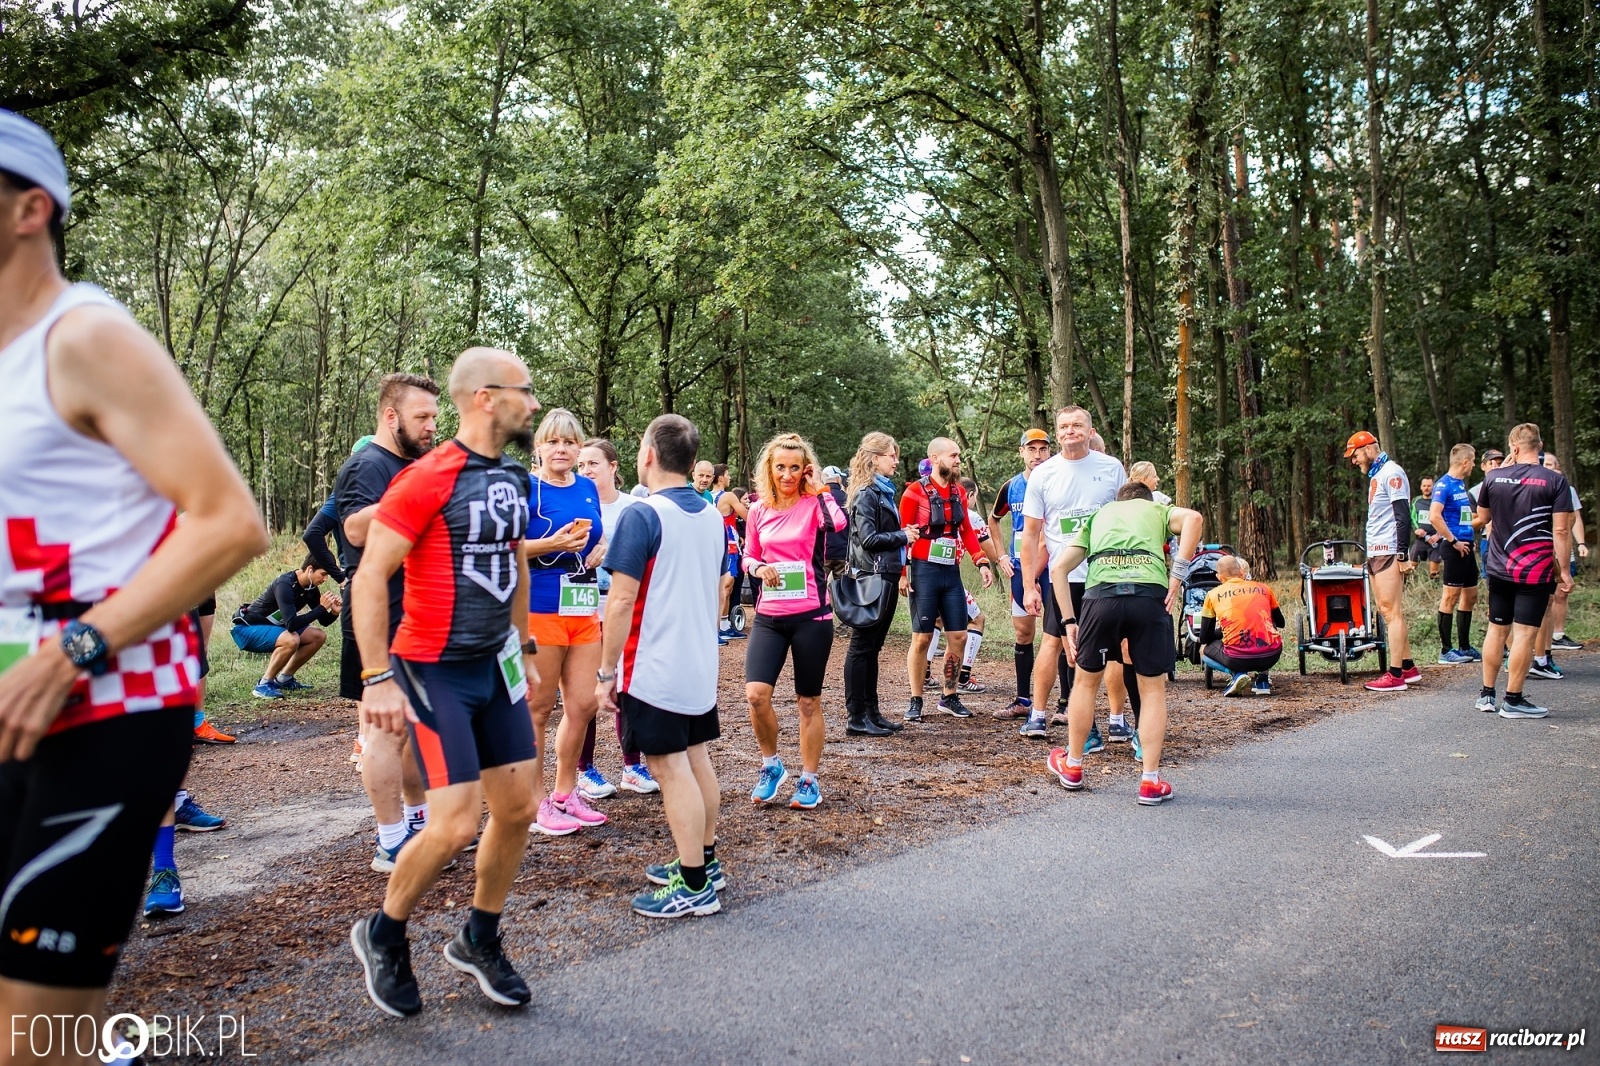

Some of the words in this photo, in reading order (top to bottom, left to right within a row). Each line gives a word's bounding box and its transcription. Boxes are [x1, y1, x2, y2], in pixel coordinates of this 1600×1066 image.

[1010, 502, 1024, 513] RU
[941, 546, 953, 558] 19
[570, 588, 595, 606] 146
